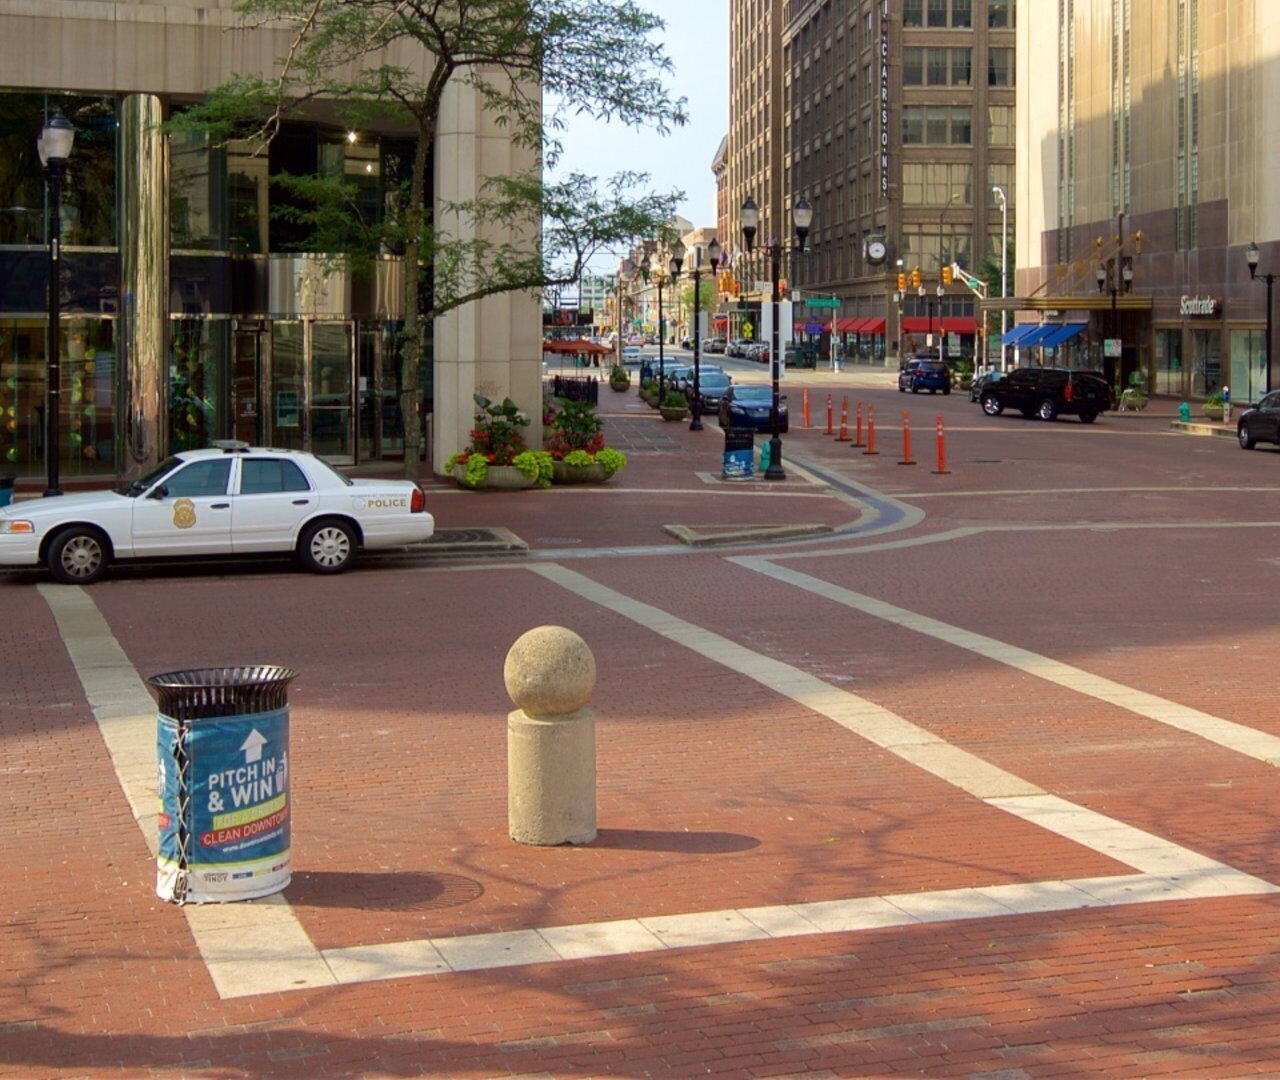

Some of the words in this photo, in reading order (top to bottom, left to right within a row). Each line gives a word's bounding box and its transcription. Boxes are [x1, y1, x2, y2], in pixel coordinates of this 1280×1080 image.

[367, 499, 407, 508] POLICE
[208, 763, 258, 790] PITCH
[262, 757, 276, 777] IN
[207, 791, 225, 812] &
[230, 775, 273, 808] WIN
[203, 828, 241, 846] CLEAN
